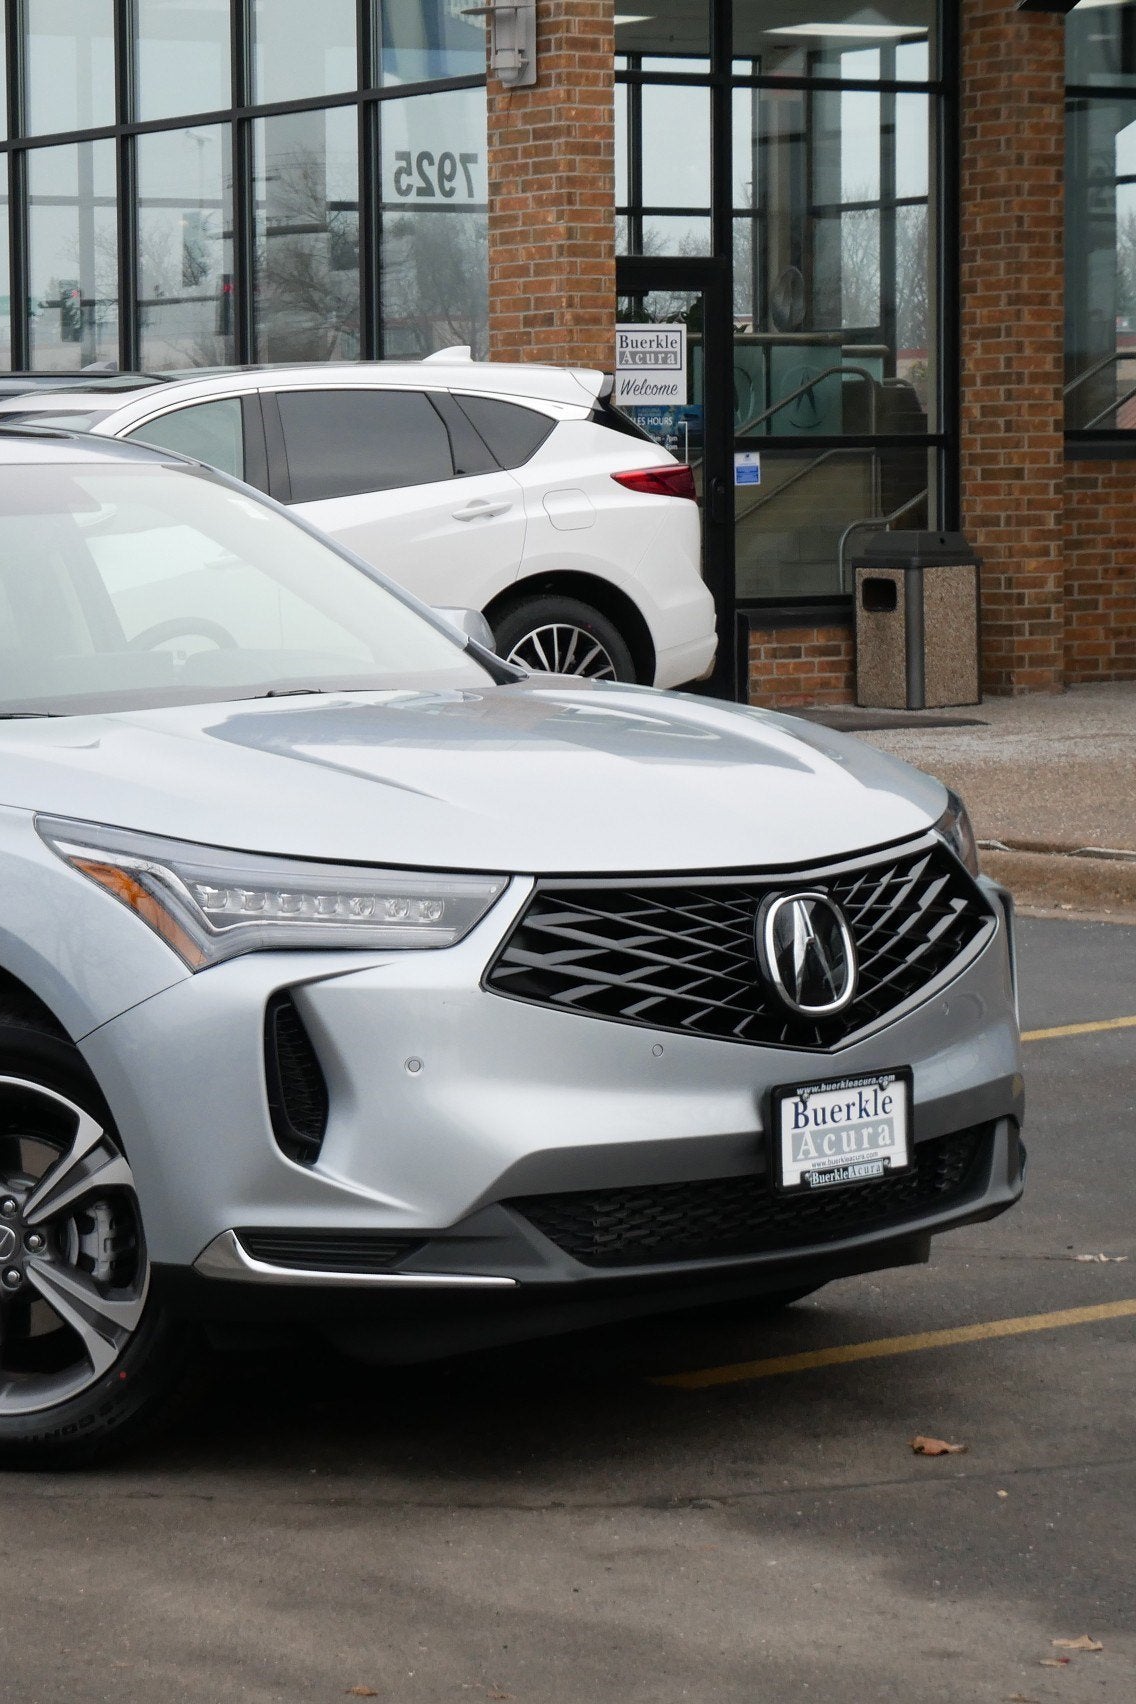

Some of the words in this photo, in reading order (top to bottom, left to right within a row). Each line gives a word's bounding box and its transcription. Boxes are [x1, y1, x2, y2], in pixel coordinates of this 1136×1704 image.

[619, 334, 678, 349] Buerkle
[621, 350, 676, 364] Acura
[620, 378, 678, 396] Welcome
[647, 417, 673, 425] HOURS
[792, 1089, 893, 1130] Buerkle
[796, 1124, 891, 1160] Acura
[812, 1168, 849, 1184] Buerkle
[850, 1163, 882, 1178] Acura
